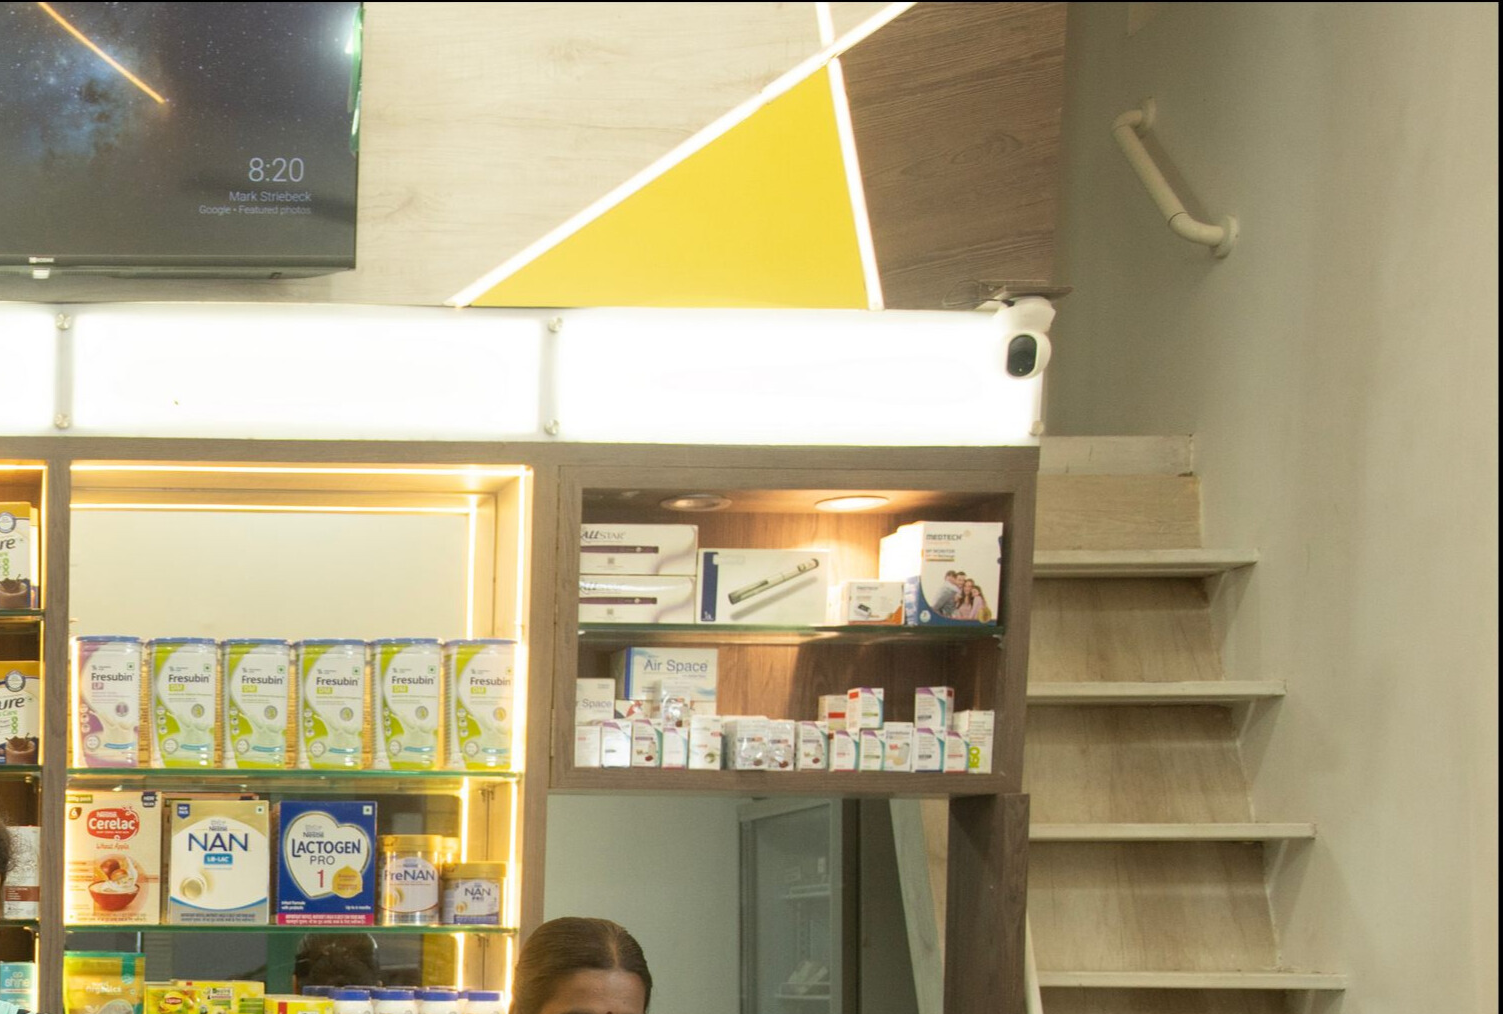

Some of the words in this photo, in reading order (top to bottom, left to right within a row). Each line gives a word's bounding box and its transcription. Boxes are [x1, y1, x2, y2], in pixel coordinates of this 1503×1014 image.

[248, 157, 305, 182] 8:20
[229, 191, 257, 202] Mark
[260, 191, 312, 202] Striebeck
[199, 205, 231, 216] Google
[238, 205, 278, 214] Featured
[644, 660, 662, 671] Air
[666, 660, 708, 674] Space
[91, 672, 134, 682] Fresubin
[168, 674, 210, 684] Fresubin
[241, 675, 283, 685] Fresubin
[316, 676, 358, 687] Fresubin
[391, 675, 434, 685] Fresubin
[470, 676, 511, 686] Fresubin
[582, 699, 612, 708] Space
[88, 817, 135, 831] Cerelac
[188, 833, 249, 852] NAN
[292, 839, 361, 858] LACTOGEN
[310, 856, 336, 865] PRO
[317, 869, 325, 888] 1
[464, 888, 491, 897] NAN
